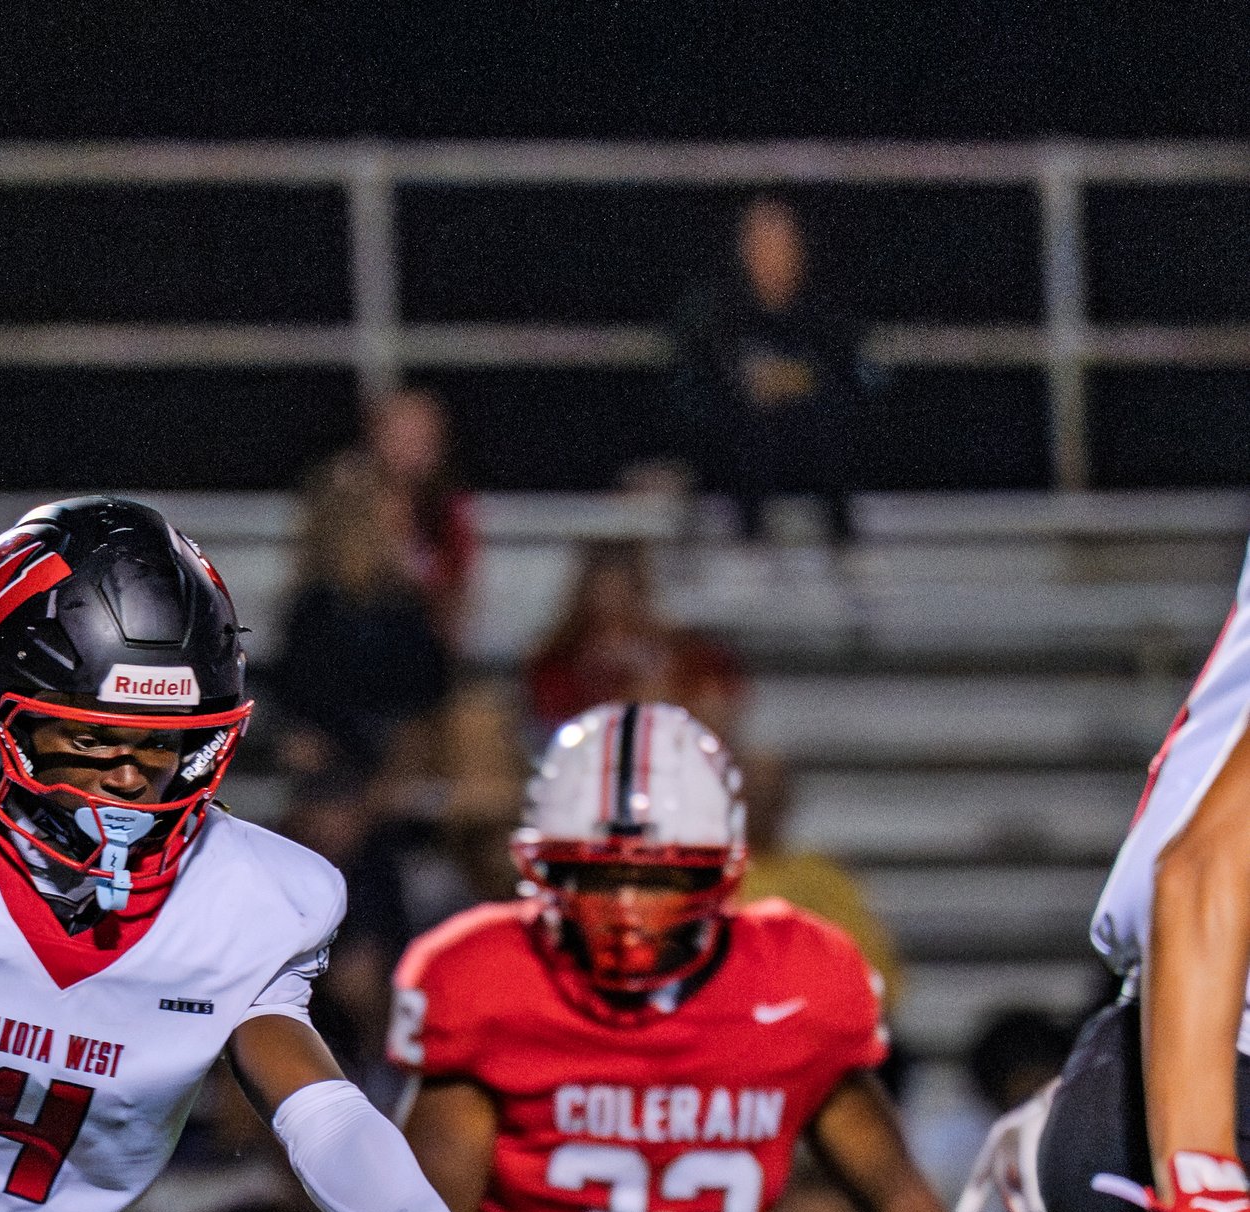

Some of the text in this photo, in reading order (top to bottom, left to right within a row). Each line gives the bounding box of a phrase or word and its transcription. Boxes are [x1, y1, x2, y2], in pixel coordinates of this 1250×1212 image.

[115, 676, 192, 695] Riddell
[65, 1034, 125, 1077] WEST
[553, 1084, 785, 1142] COLERAIN
